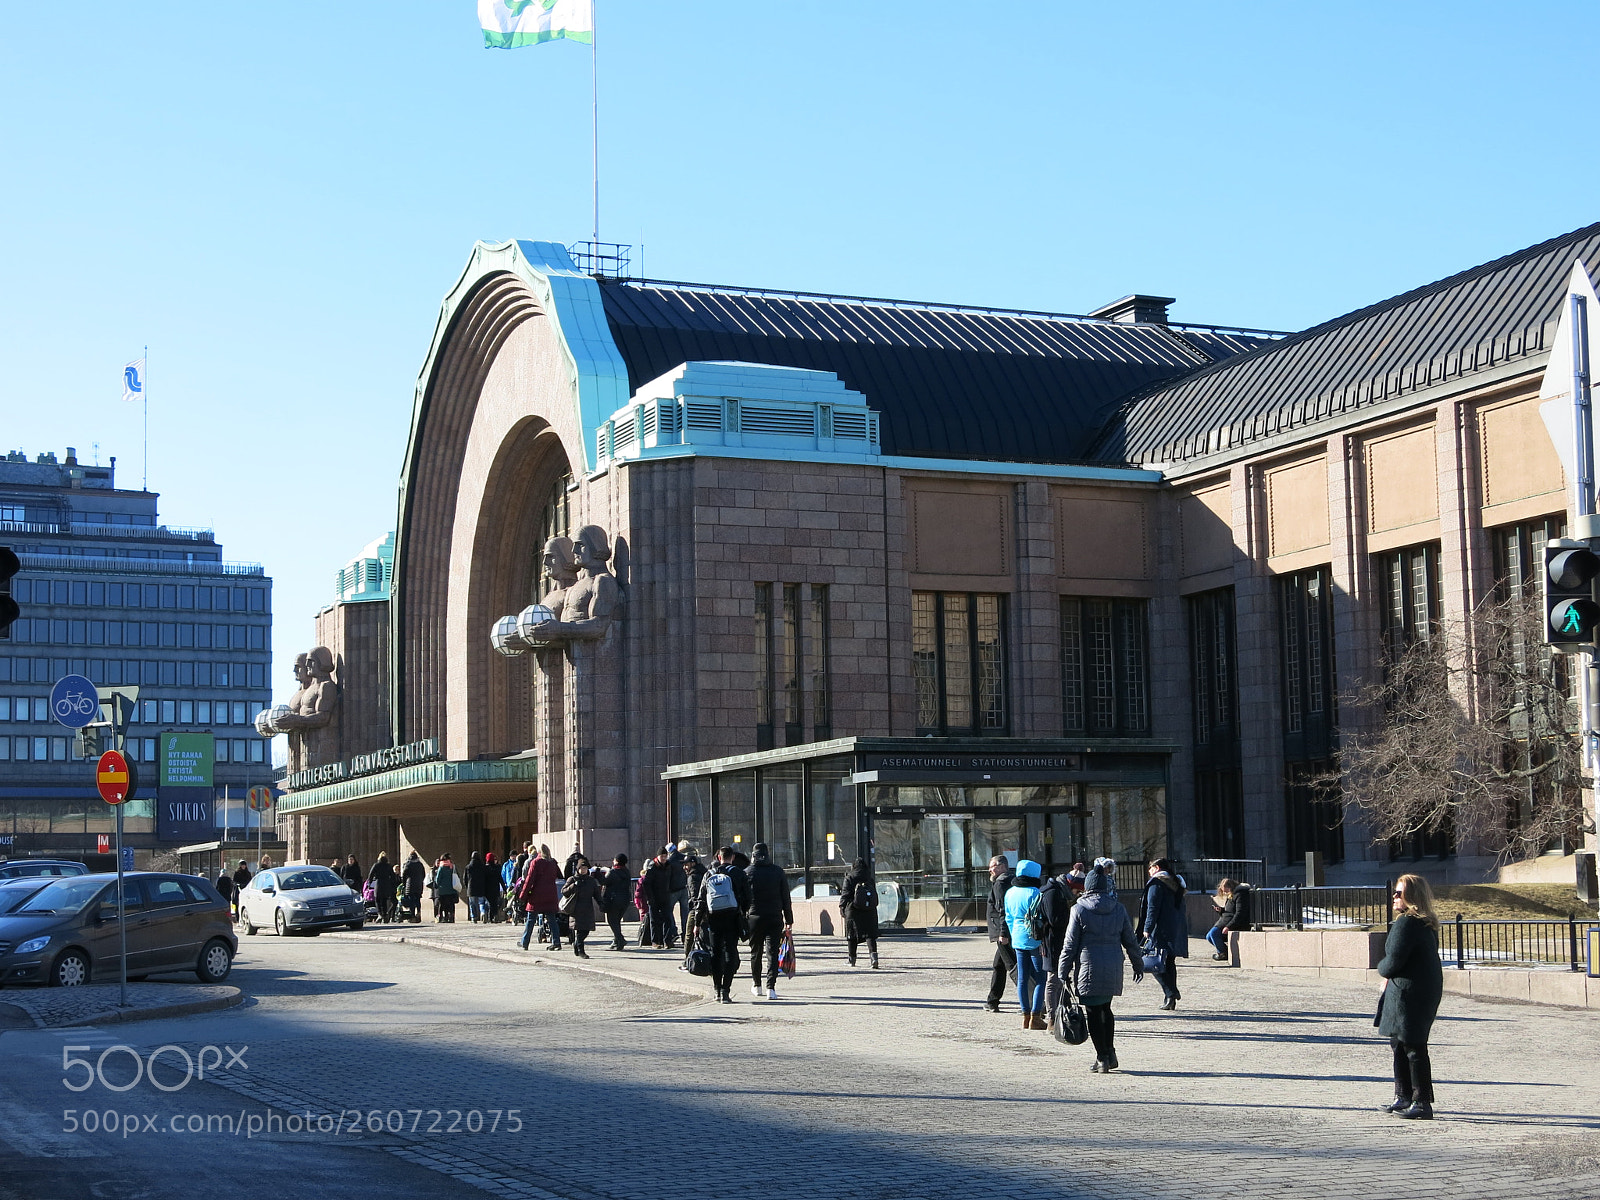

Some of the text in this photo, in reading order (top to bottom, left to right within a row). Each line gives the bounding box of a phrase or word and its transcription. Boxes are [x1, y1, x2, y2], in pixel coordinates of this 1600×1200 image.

[287, 739, 433, 788] RAUTATIEASEMA JÄRNVÄGSSTATION
[882, 758, 1067, 767] ASEMATUNNELI STATIONSTUNNELN
[169, 802, 206, 821] SOKOS
